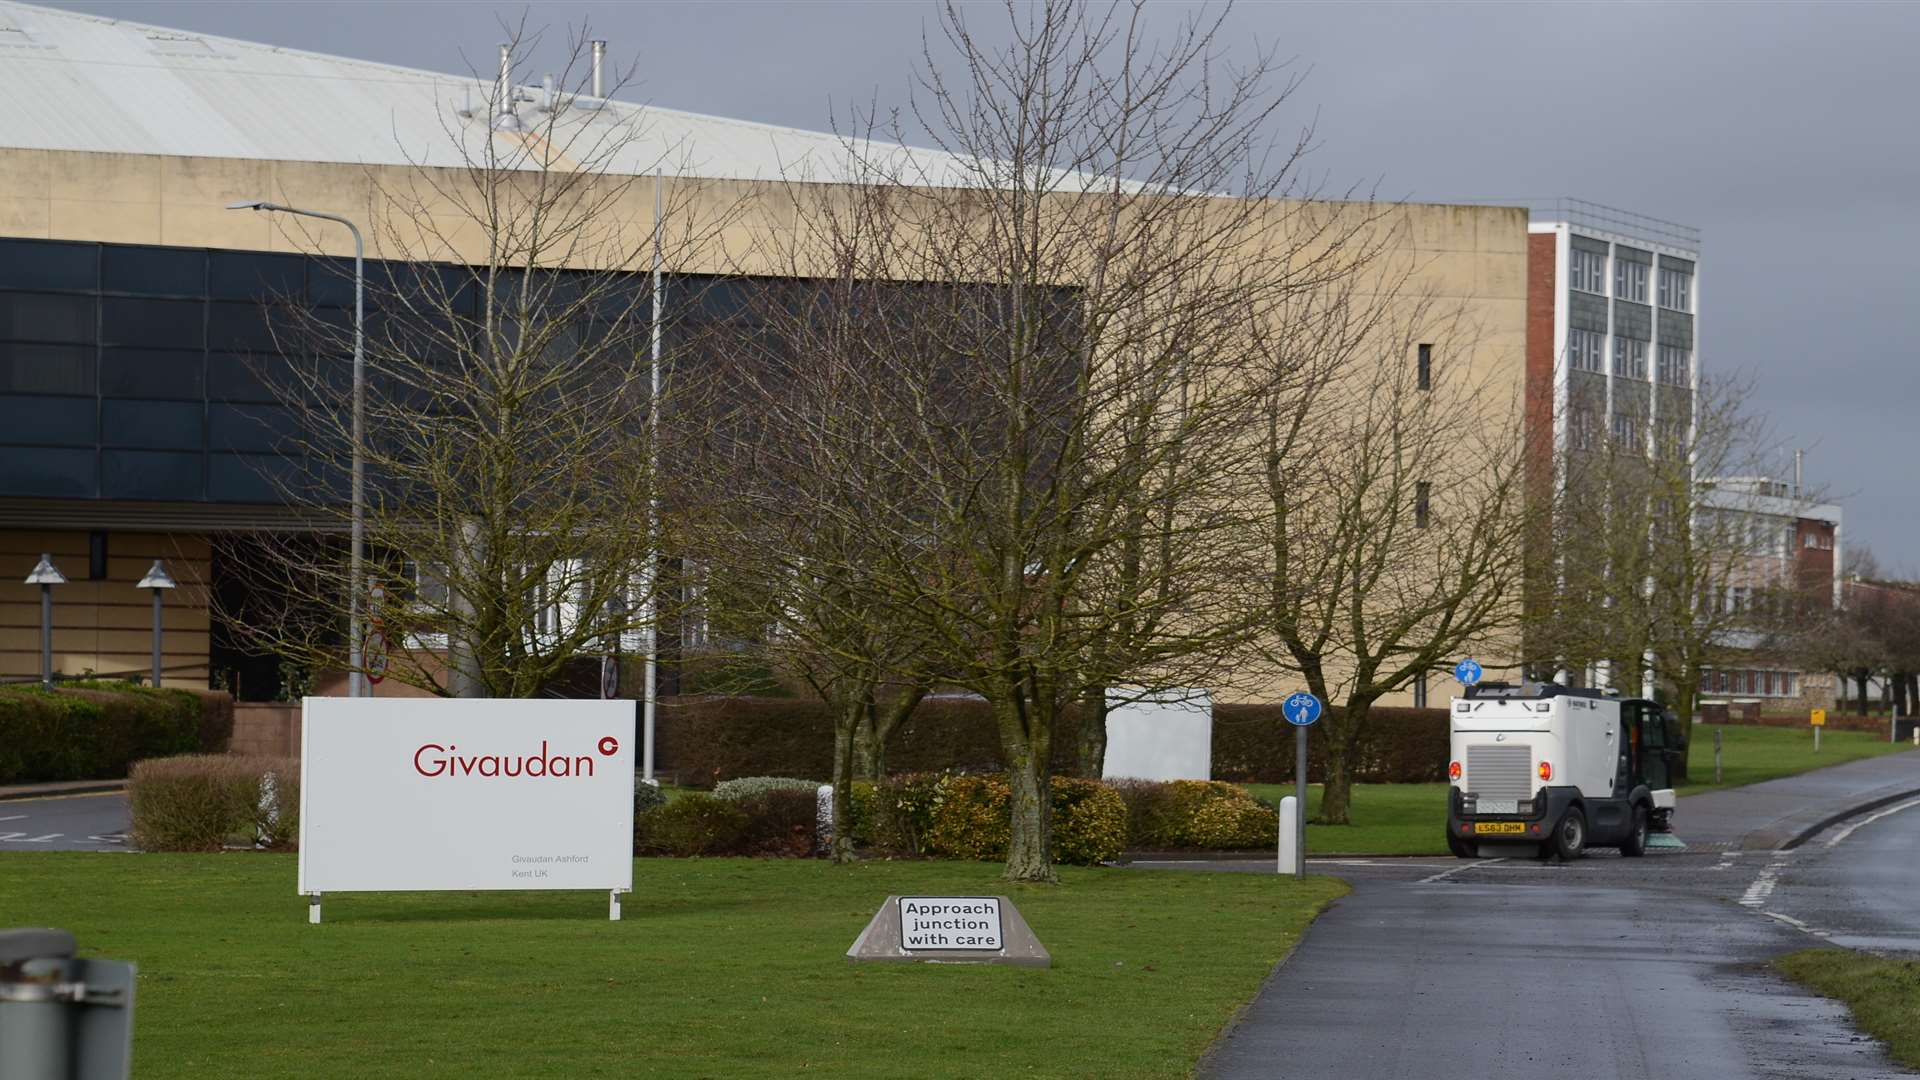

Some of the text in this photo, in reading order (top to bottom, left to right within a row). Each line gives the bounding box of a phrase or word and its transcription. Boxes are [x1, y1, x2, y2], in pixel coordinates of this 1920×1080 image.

[414, 740, 594, 777] Givaudan
[512, 854, 589, 864] Givaudan Ashford
[512, 869, 549, 879] Kent UK
[906, 903, 994, 917] Approach
[913, 918, 989, 931] junction
[909, 934, 996, 945] with care
